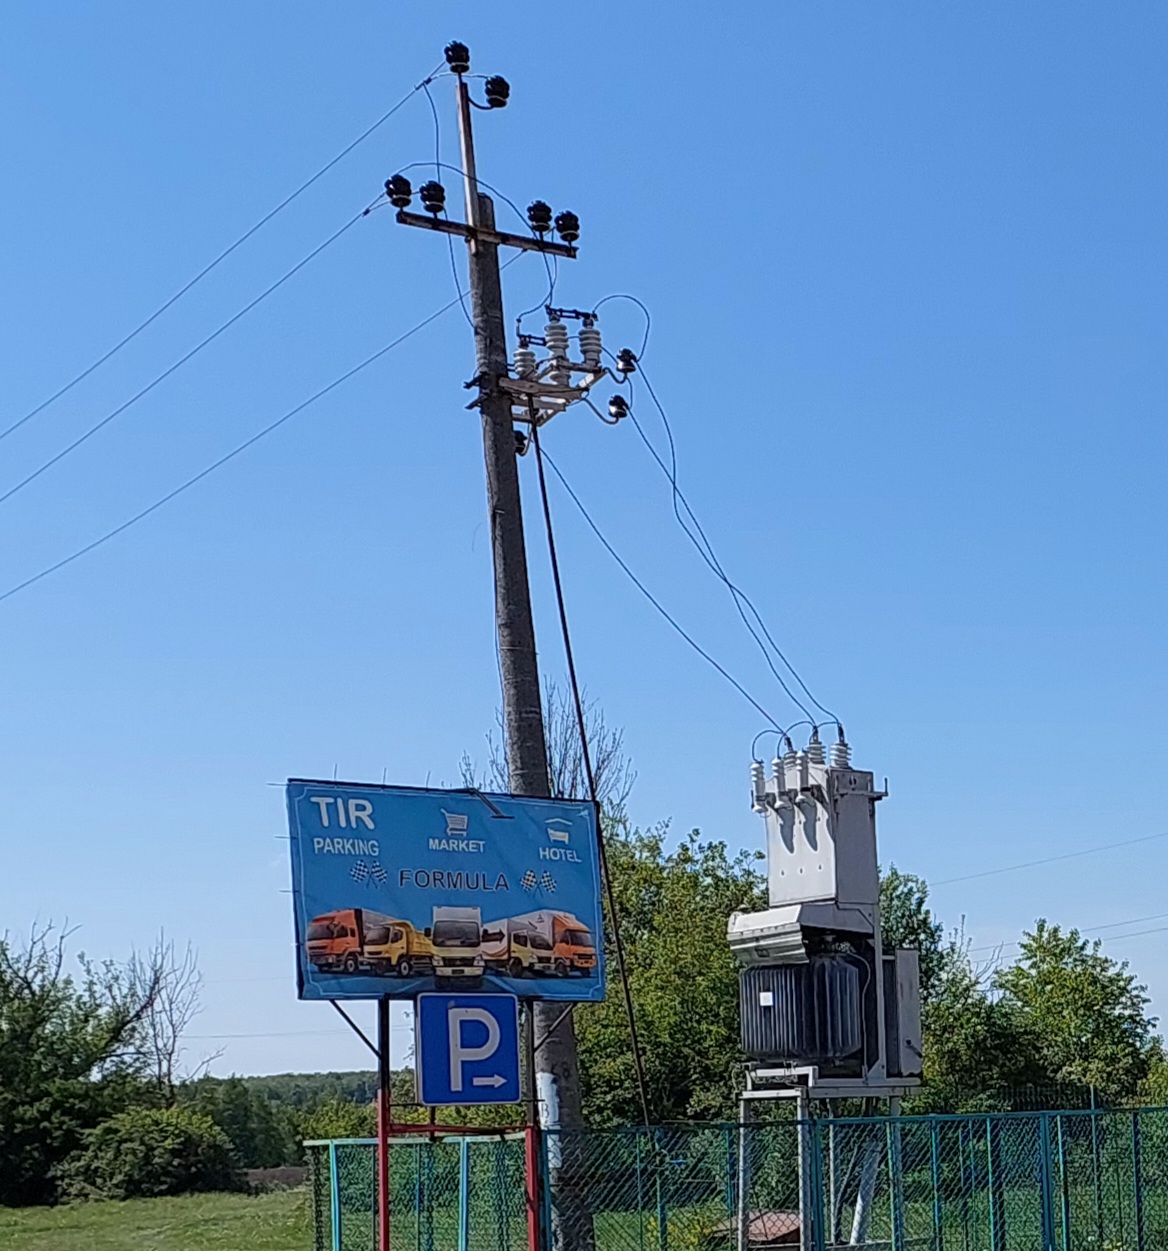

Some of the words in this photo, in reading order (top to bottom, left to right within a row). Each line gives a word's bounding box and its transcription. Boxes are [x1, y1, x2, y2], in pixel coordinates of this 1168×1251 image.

[310, 797, 375, 830] TIR
[313, 837, 379, 856] PARKING
[429, 838, 486, 853] MARKET
[539, 847, 583, 863] HOTEL
[398, 868, 510, 892] FORMULA
[448, 1008, 500, 1091] P
